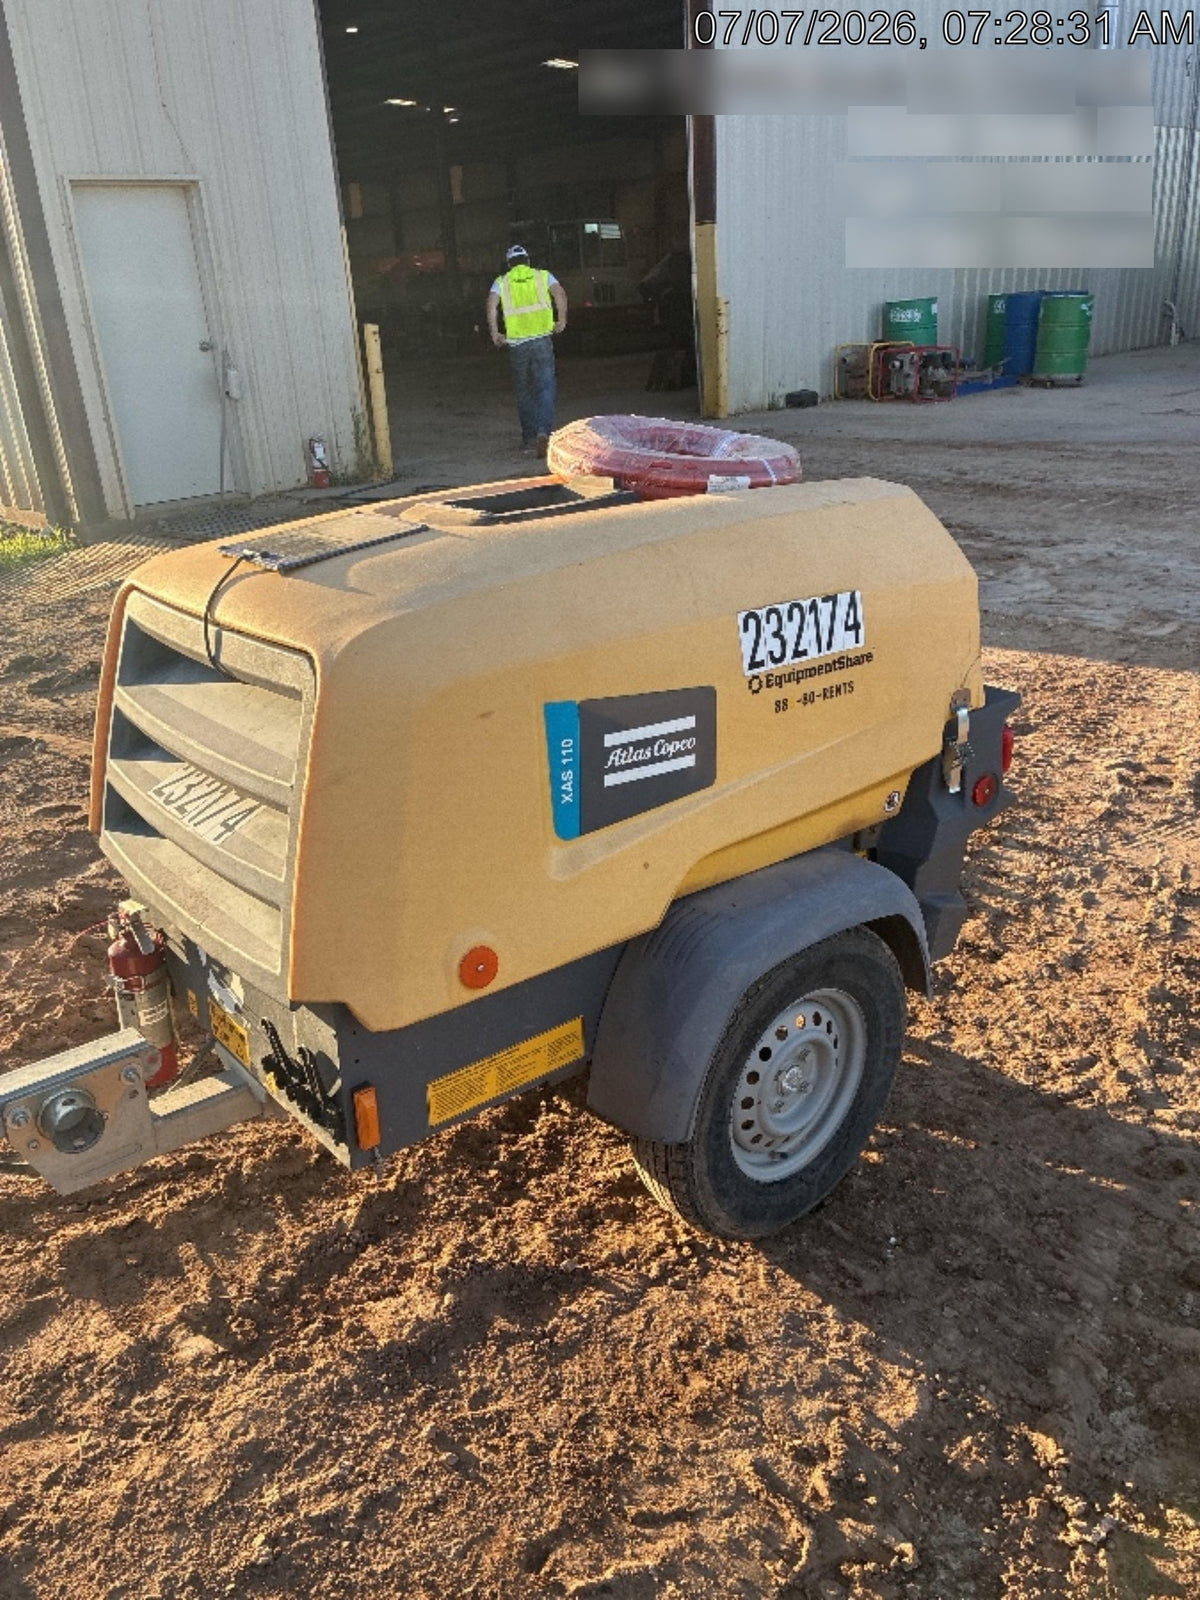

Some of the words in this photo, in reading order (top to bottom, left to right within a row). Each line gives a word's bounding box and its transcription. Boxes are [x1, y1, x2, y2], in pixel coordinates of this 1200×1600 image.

[742, 590, 861, 671] 232174
[765, 651, 874, 690] EquipmentShare
[561, 738, 574, 767] 110
[604, 745, 651, 768] Atlas
[654, 736, 696, 758] Copco
[561, 769, 574, 805] XAS
